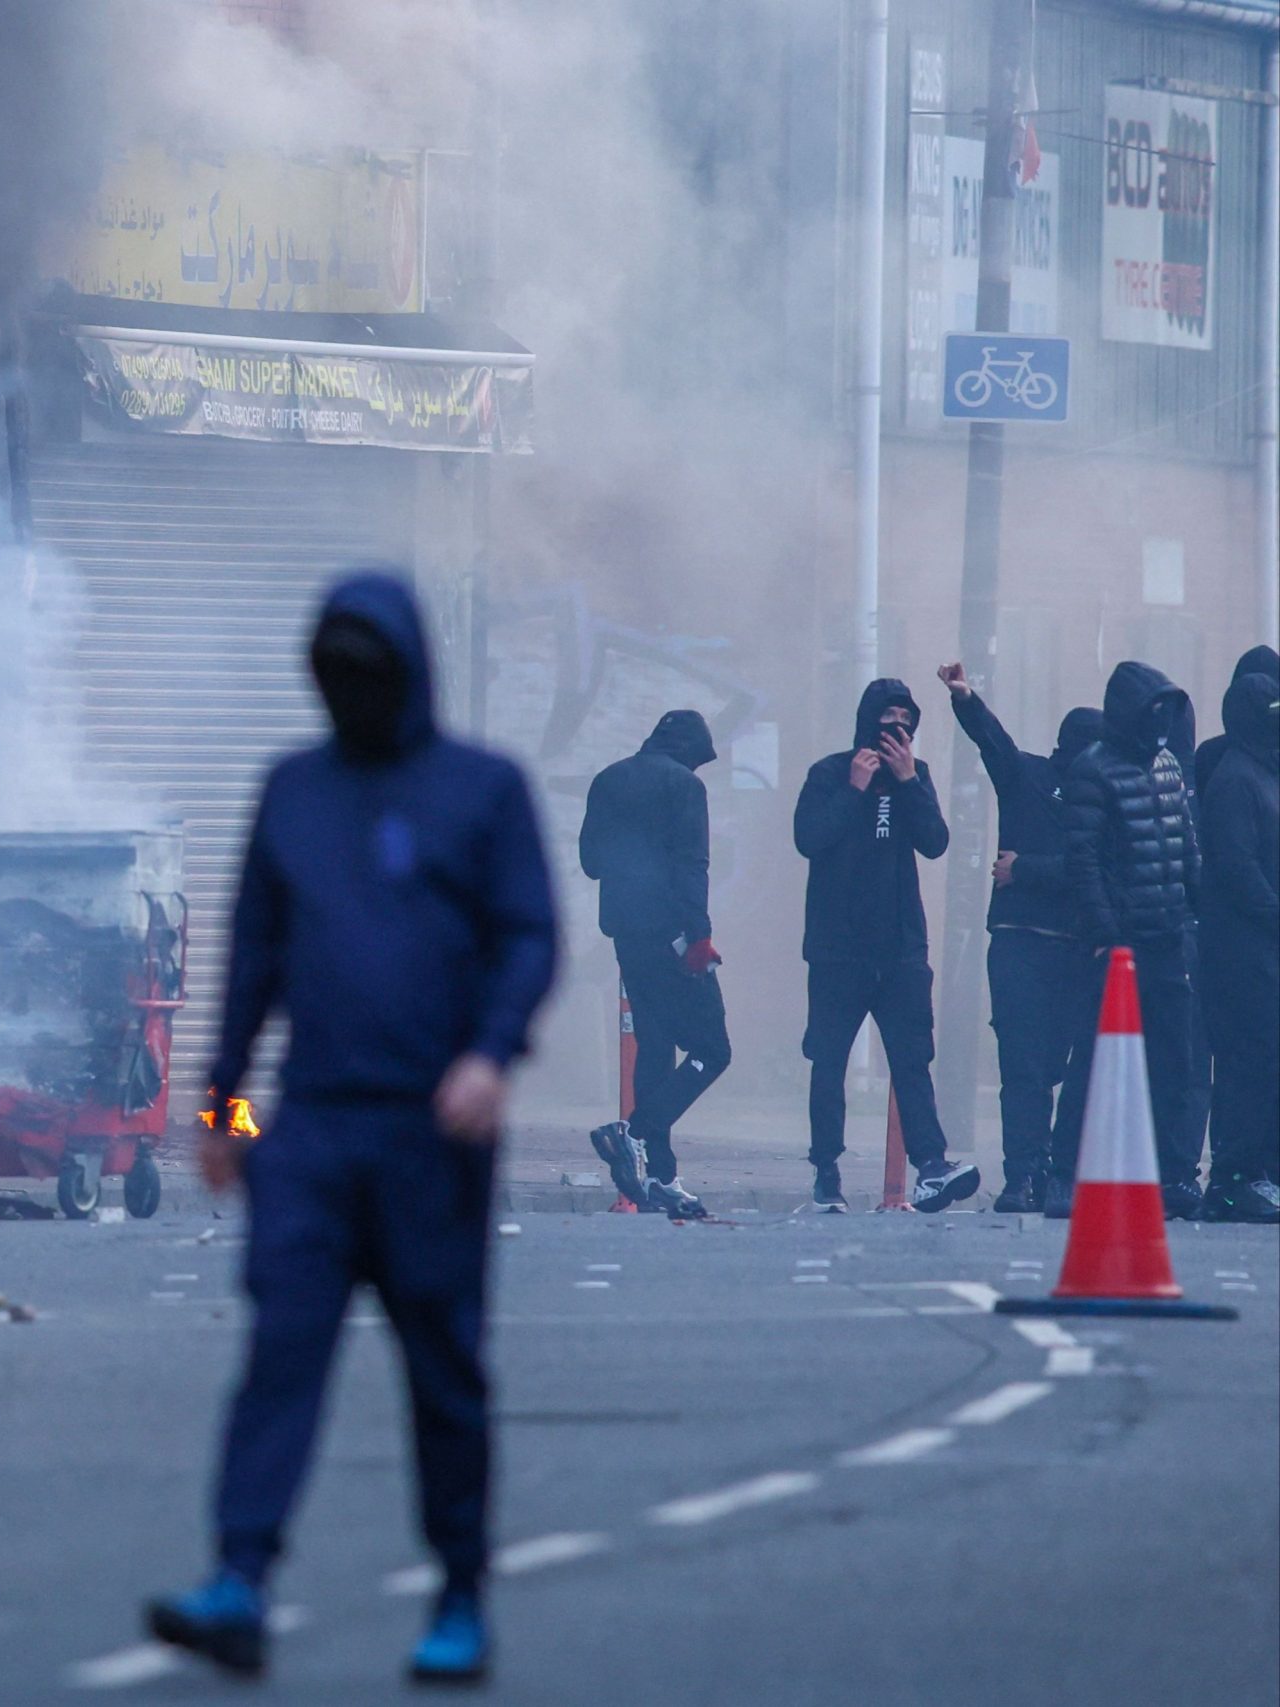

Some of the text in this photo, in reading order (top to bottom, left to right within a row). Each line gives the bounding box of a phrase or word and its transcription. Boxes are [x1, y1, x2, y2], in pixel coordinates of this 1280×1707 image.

[911, 133, 941, 197] KING
[1106, 117, 1152, 209] BCD
[180, 190, 256, 309] ماركت
[294, 361, 362, 399] MARKET
[876, 796, 891, 839] NIKE
